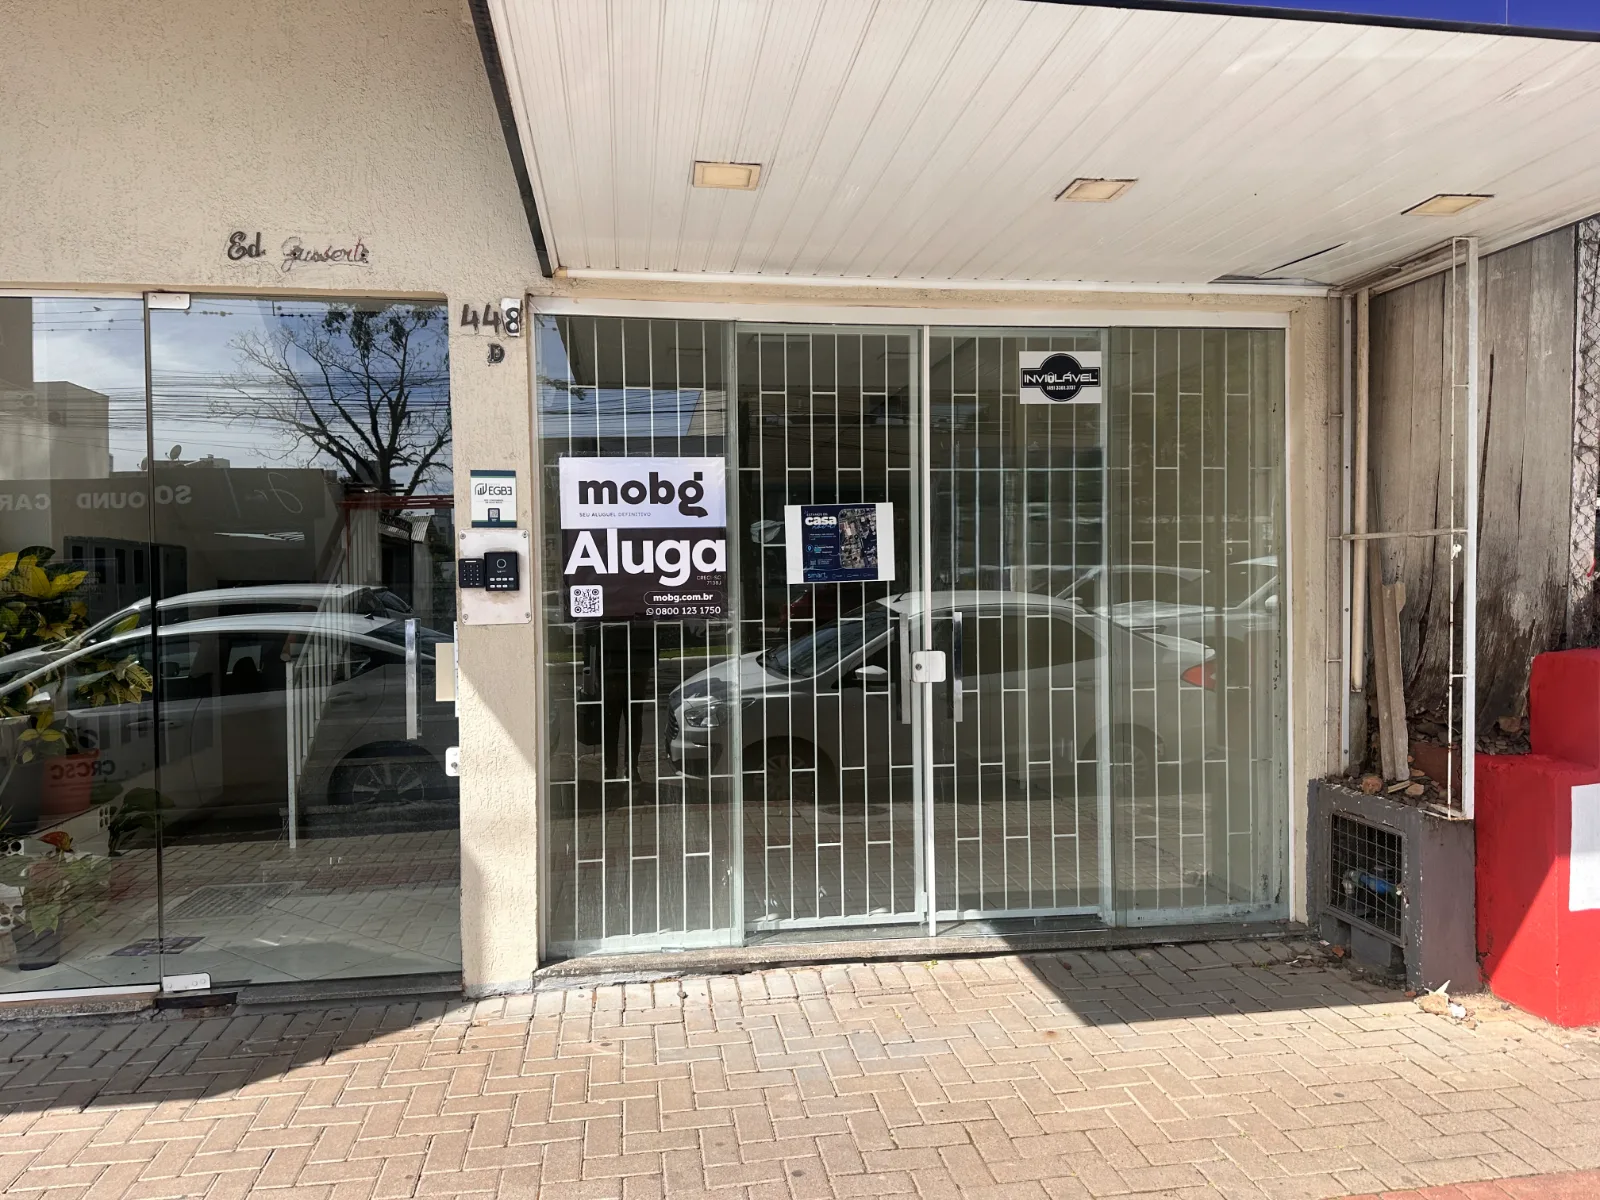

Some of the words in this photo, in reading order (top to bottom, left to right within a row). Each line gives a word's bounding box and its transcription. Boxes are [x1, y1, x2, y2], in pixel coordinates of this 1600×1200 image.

[460, 303, 521, 334] 448
[487, 343, 506, 364] D
[577, 471, 709, 518] mobg
[805, 516, 837, 525] casa
[563, 528, 727, 587] Aluga
[652, 592, 714, 603] mobg.com.br
[655, 606, 679, 616] 0800
[681, 606, 697, 615] 123
[699, 606, 721, 615] 1750
